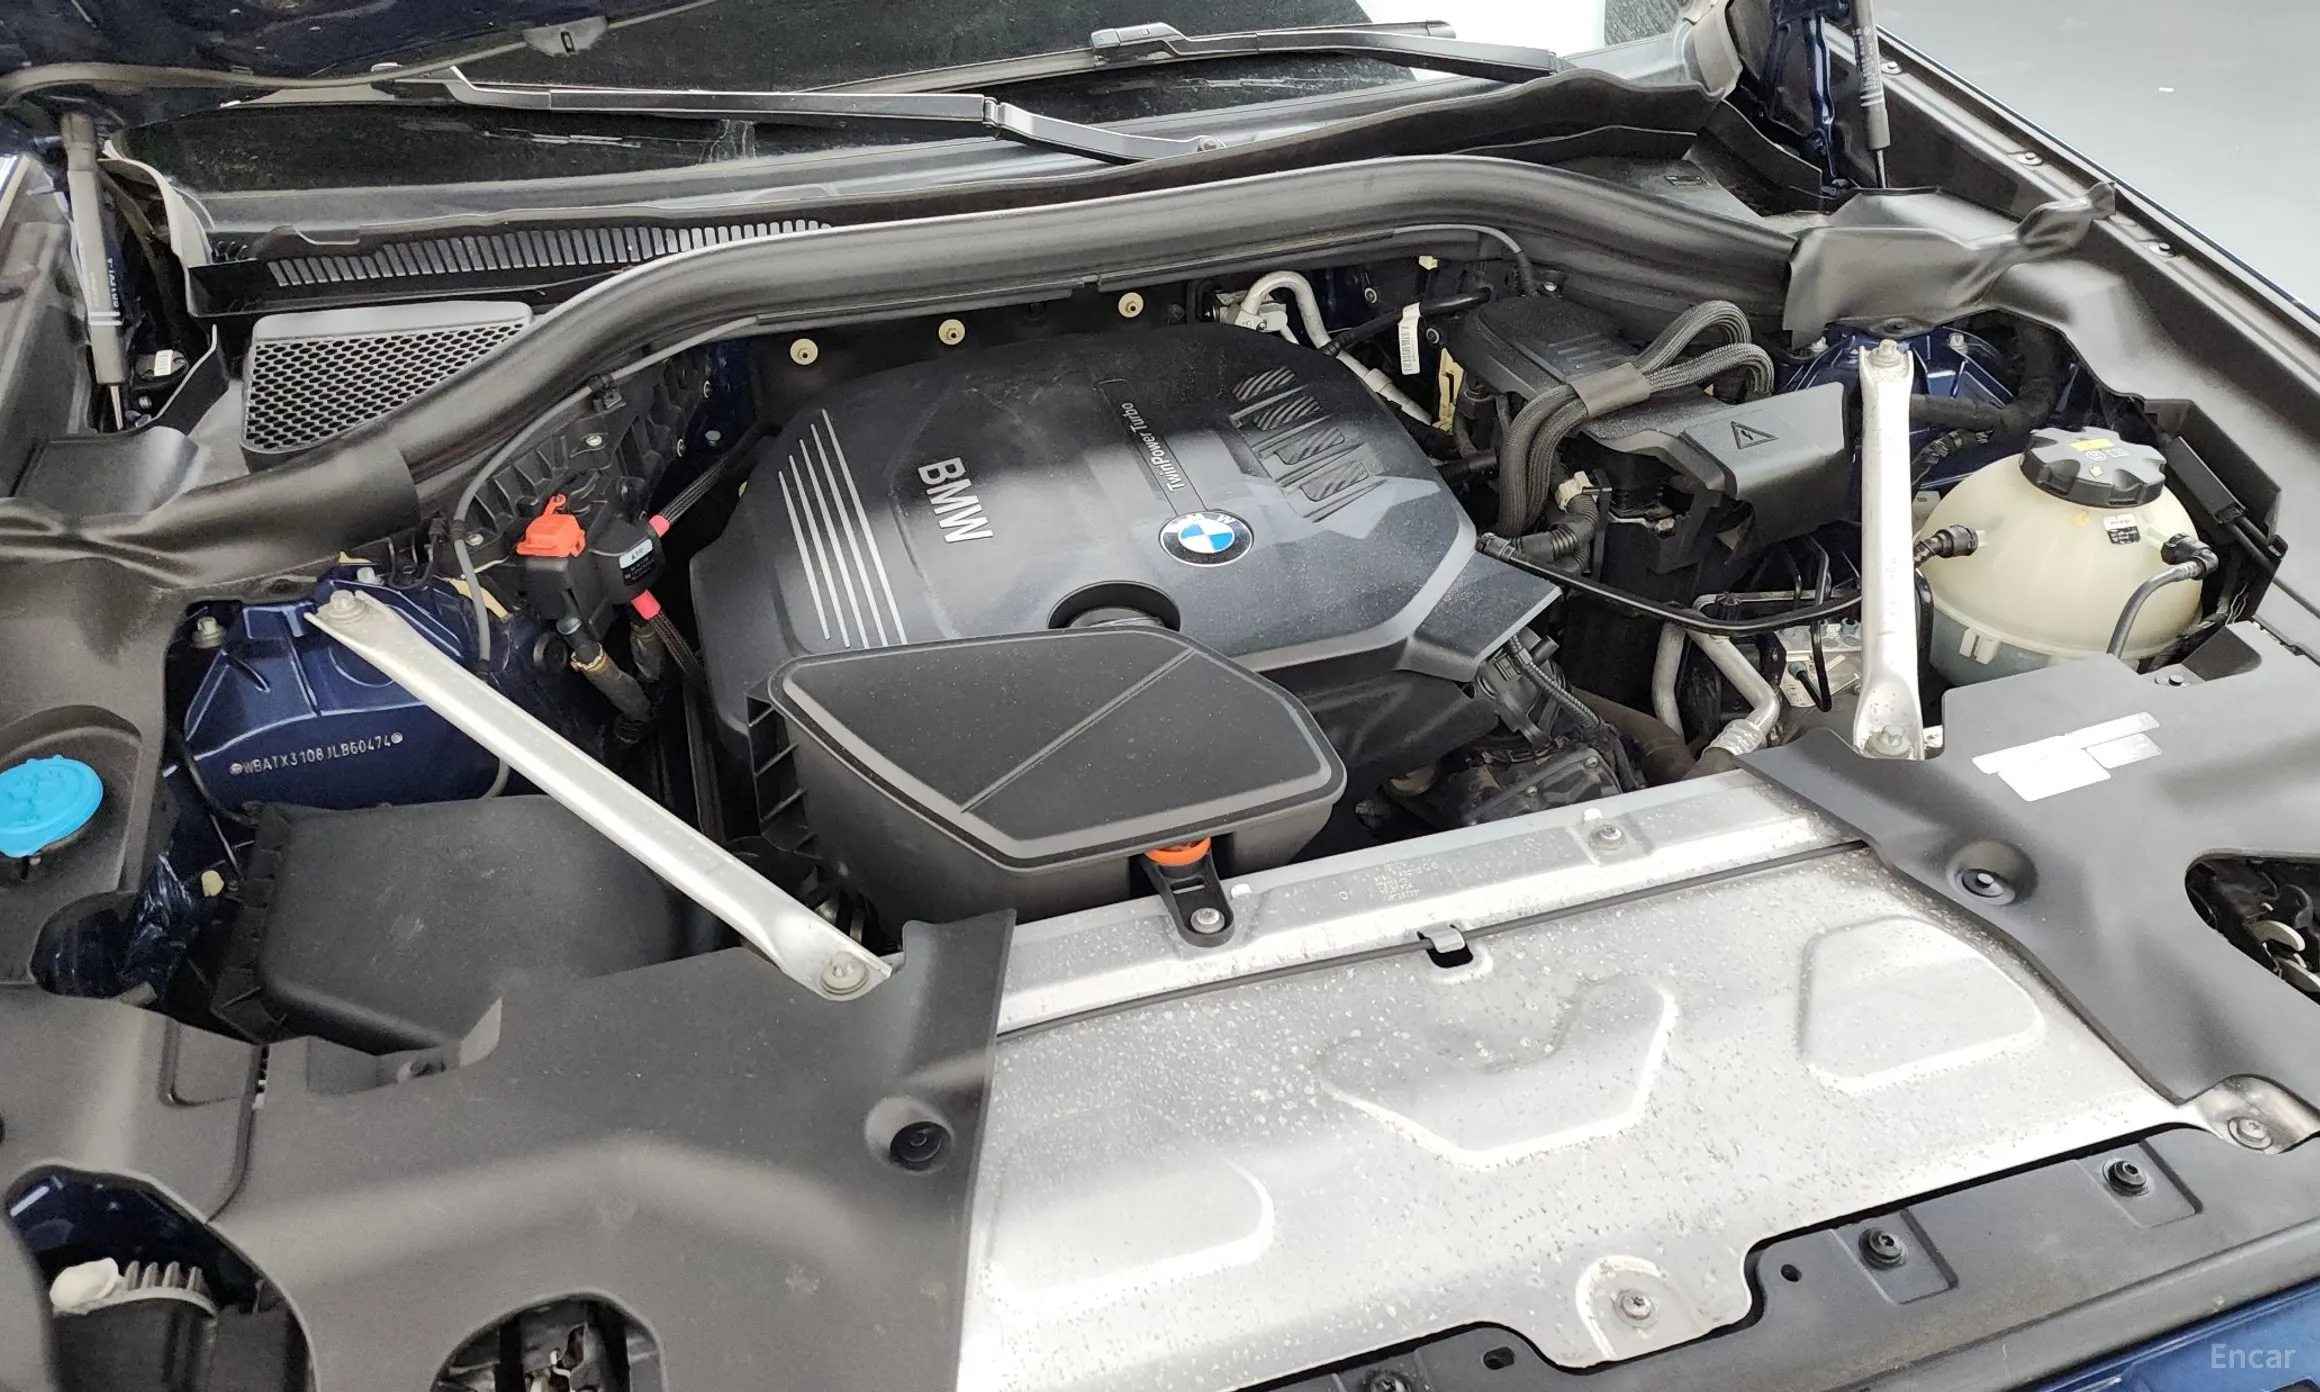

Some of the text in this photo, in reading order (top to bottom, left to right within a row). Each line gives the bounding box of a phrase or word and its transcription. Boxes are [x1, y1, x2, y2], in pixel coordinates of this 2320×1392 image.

[1121, 402, 1186, 492] TwinPower Turbo
[918, 457, 994, 543] BMW
